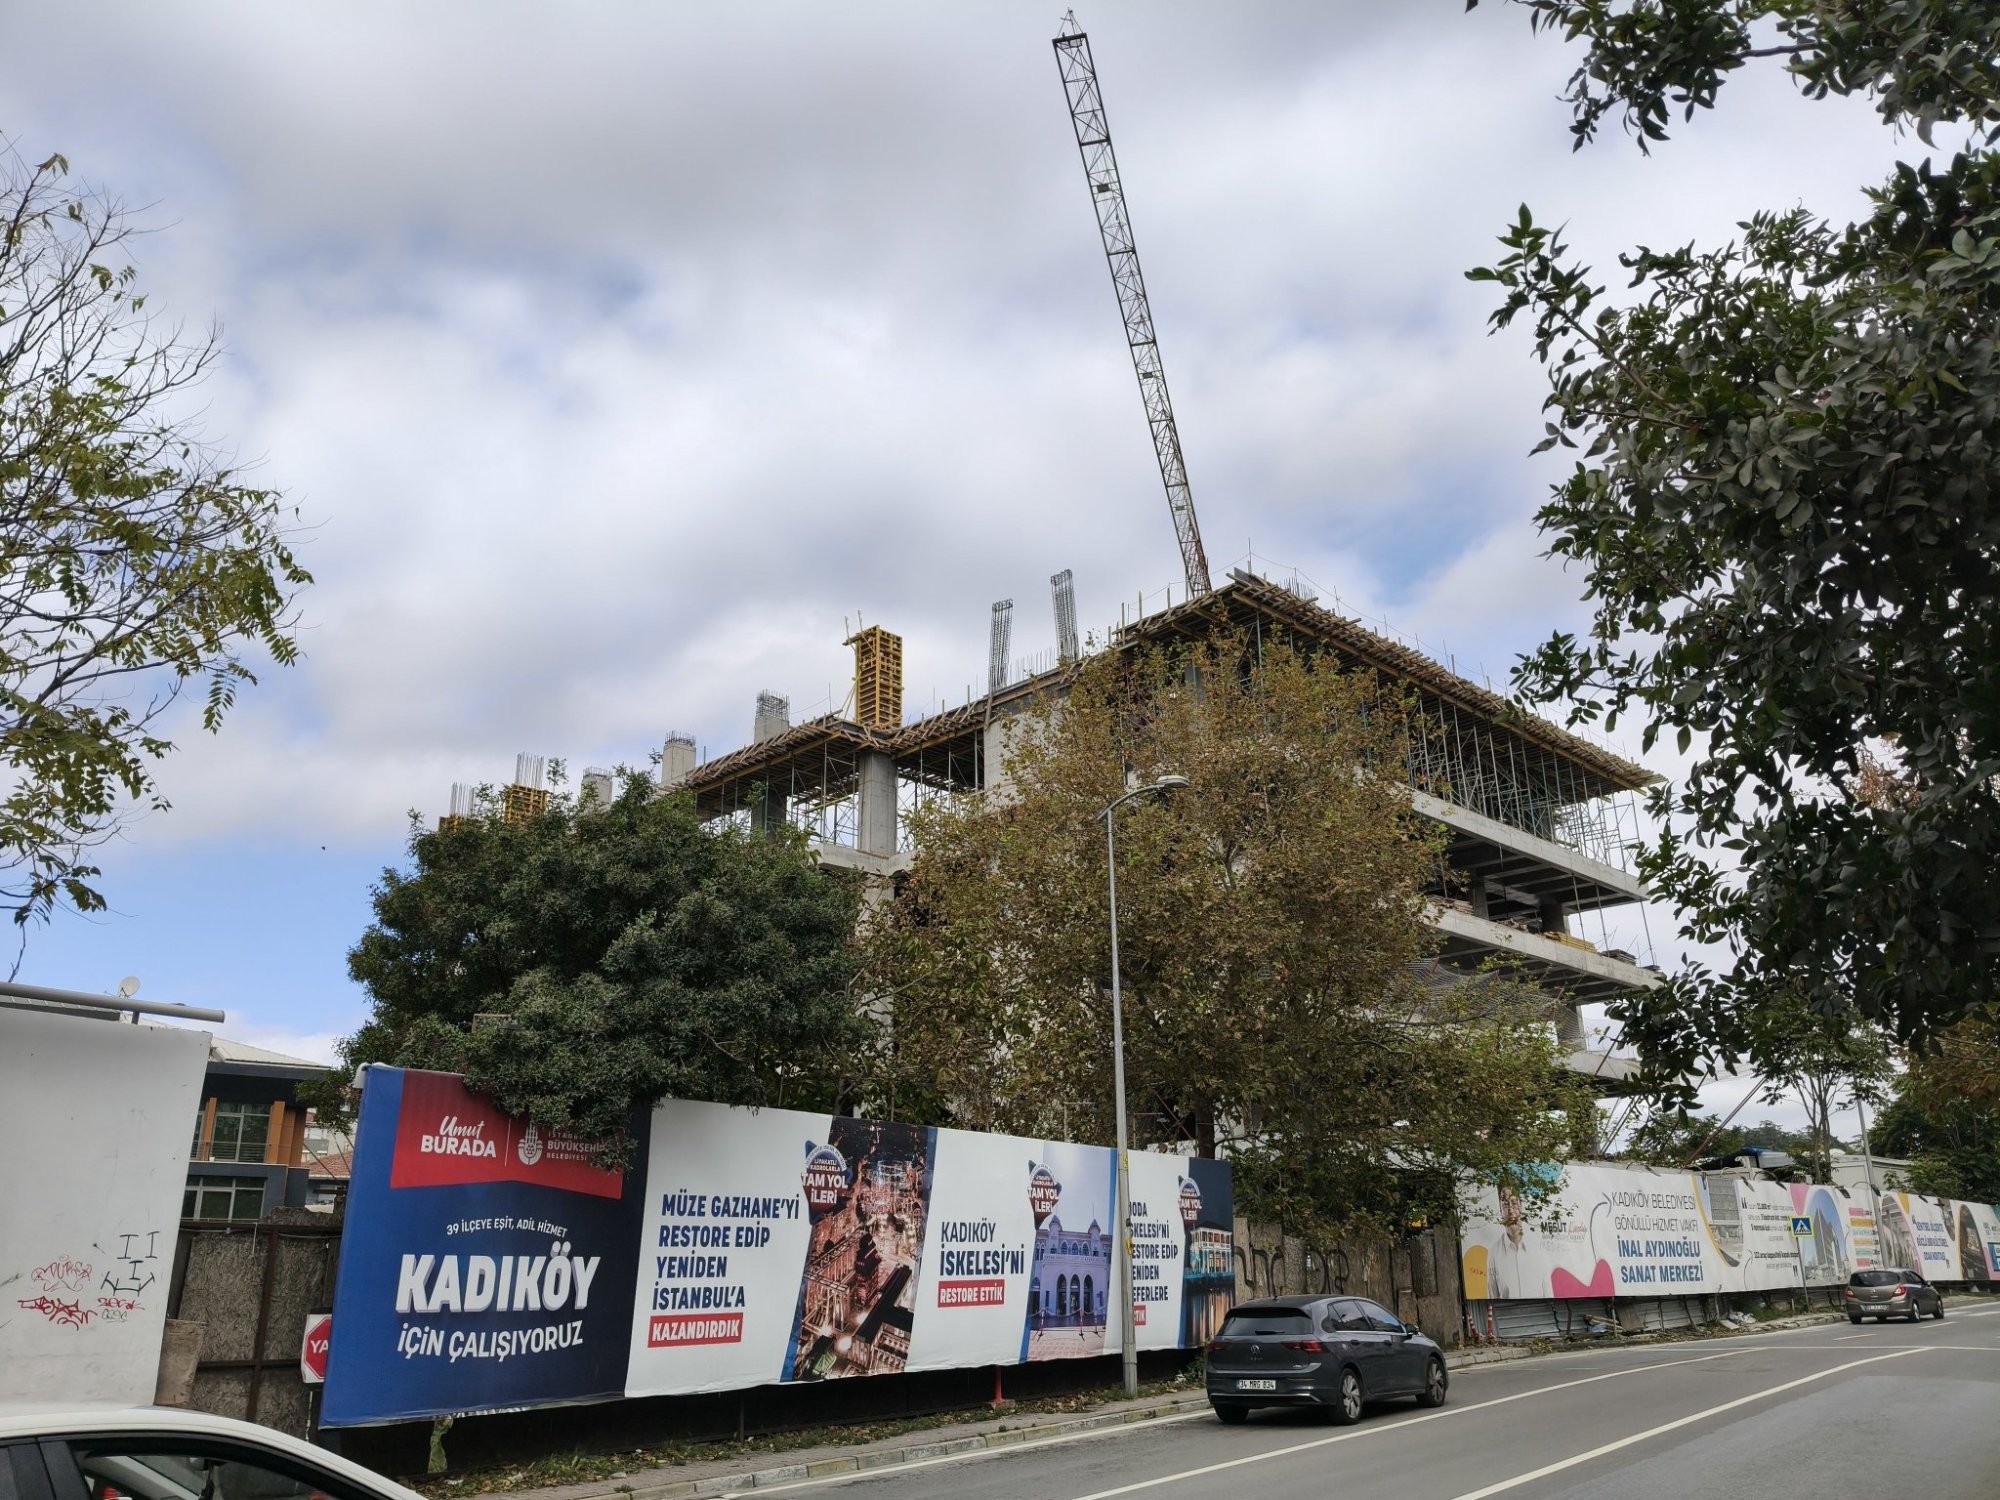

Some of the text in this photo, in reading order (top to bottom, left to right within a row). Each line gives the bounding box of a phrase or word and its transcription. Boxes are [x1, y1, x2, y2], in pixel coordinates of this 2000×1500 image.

[439, 1115, 485, 1137] Umut
[421, 1135, 497, 1158] BURADA
[801, 1172, 849, 1189] TAM YOL
[661, 1189, 800, 1219] MÜZE GAZHANE'Yİ
[810, 1188, 838, 1204] İLERİ
[1045, 1188, 1060, 1200] YOL
[1611, 1190, 1697, 1210] KADIKÖY BELEDİYESİ
[446, 1215, 568, 1238] 39 İLÇEYE EŞİT, ADİL HİZMET
[658, 1220, 770, 1248] RESTORE EDİP
[941, 1217, 996, 1243] KADIKÖY
[1130, 1219, 1170, 1239] SKELESİ'Nİ
[1614, 1214, 1652, 1231] GÖNÜLLÜ
[1652, 1215, 1678, 1232] HİZMET
[1131, 1240, 1179, 1260] ESTORE EDİP
[1617, 1234, 1701, 1258] İNAL AYDINOĞLU
[656, 1250, 728, 1279] YENİDEN
[940, 1243, 1024, 1276] İSKELESİ'Nİ
[1132, 1260, 1160, 1280] ENİDEN
[395, 1240, 601, 1314] KADIKÖY
[1620, 1260, 1704, 1284] SANAT MERKEZİ
[652, 1281, 746, 1310] İSTANBUL'A
[940, 1282, 1004, 1304] RESTORE ETTİK
[1133, 1285, 1169, 1302] EFERLERE
[397, 1320, 584, 1363] İÇİN ÇALIŞIYORUZ
[652, 1319, 741, 1342] KAZANDIRDIK
